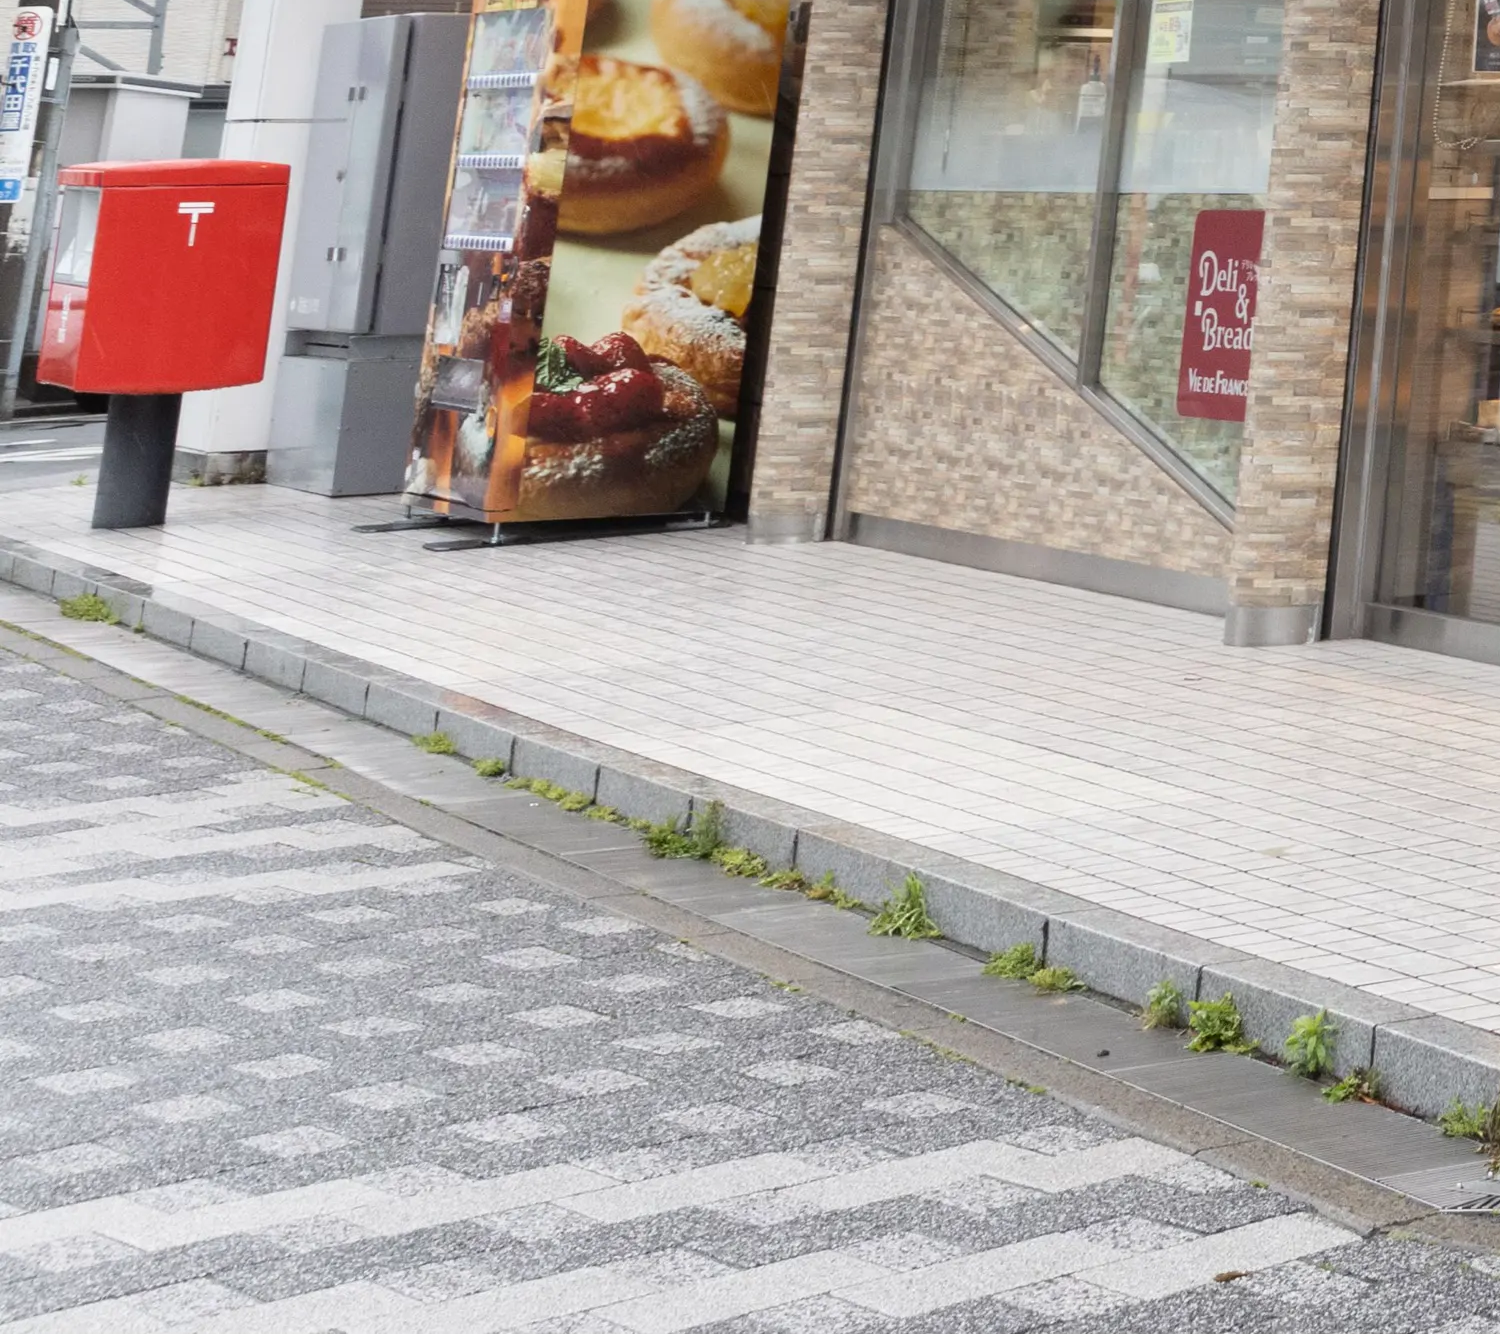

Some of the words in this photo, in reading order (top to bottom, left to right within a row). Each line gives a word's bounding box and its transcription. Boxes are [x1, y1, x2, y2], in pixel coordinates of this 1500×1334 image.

[1200, 250, 1240, 297] Deli
[1235, 283, 1250, 325] &
[1201, 307, 1256, 352] Bread
[1188, 367, 1203, 394] VIE
[1203, 376, 1216, 394] DE
[1215, 369, 1249, 397] FRANCE
